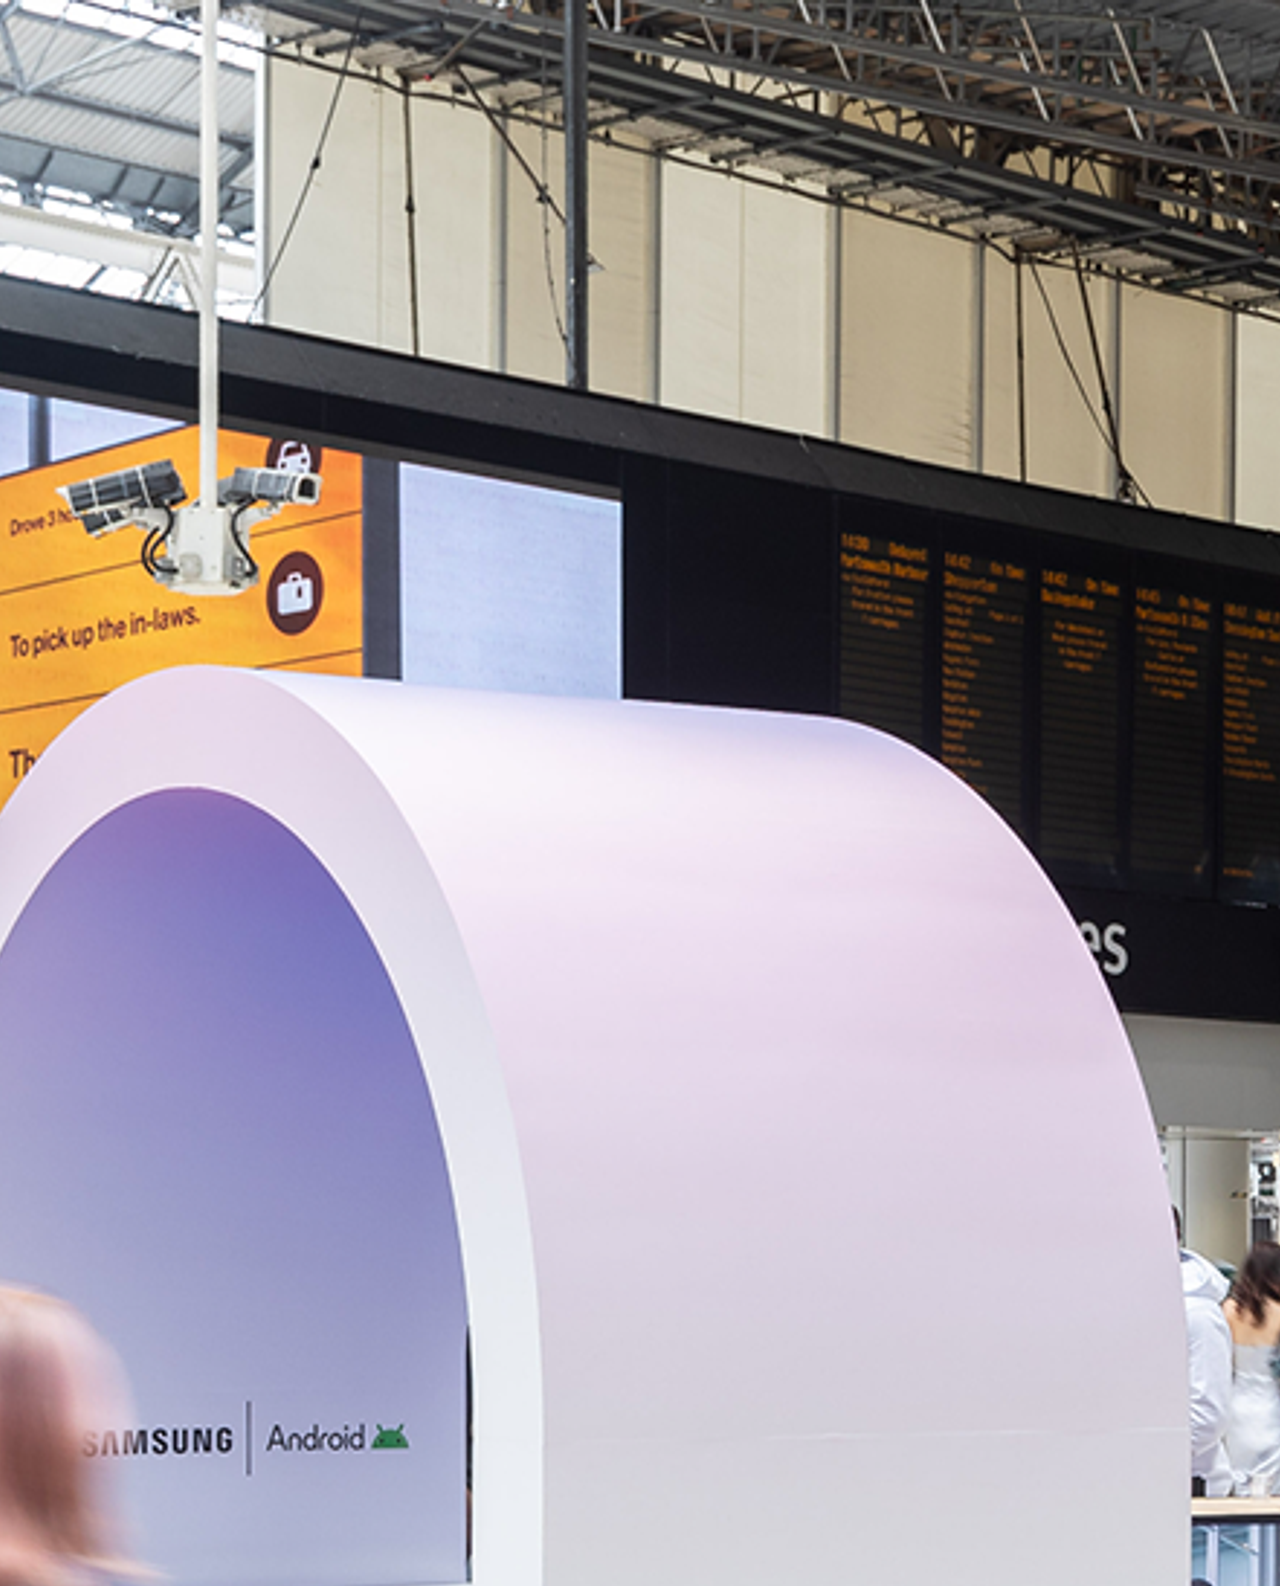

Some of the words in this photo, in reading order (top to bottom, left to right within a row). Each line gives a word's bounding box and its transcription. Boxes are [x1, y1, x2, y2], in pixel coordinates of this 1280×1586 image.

[10, 515, 44, 537] Drove
[48, 511, 56, 527] 3
[58, 507, 80, 523] ho
[10, 634, 29, 658] To
[33, 626, 69, 658] pick
[72, 626, 94, 649] up
[98, 617, 126, 642] the
[130, 606, 201, 636] in-laws.
[1081, 920, 1128, 976] es
[266, 1424, 367, 1453] Android
